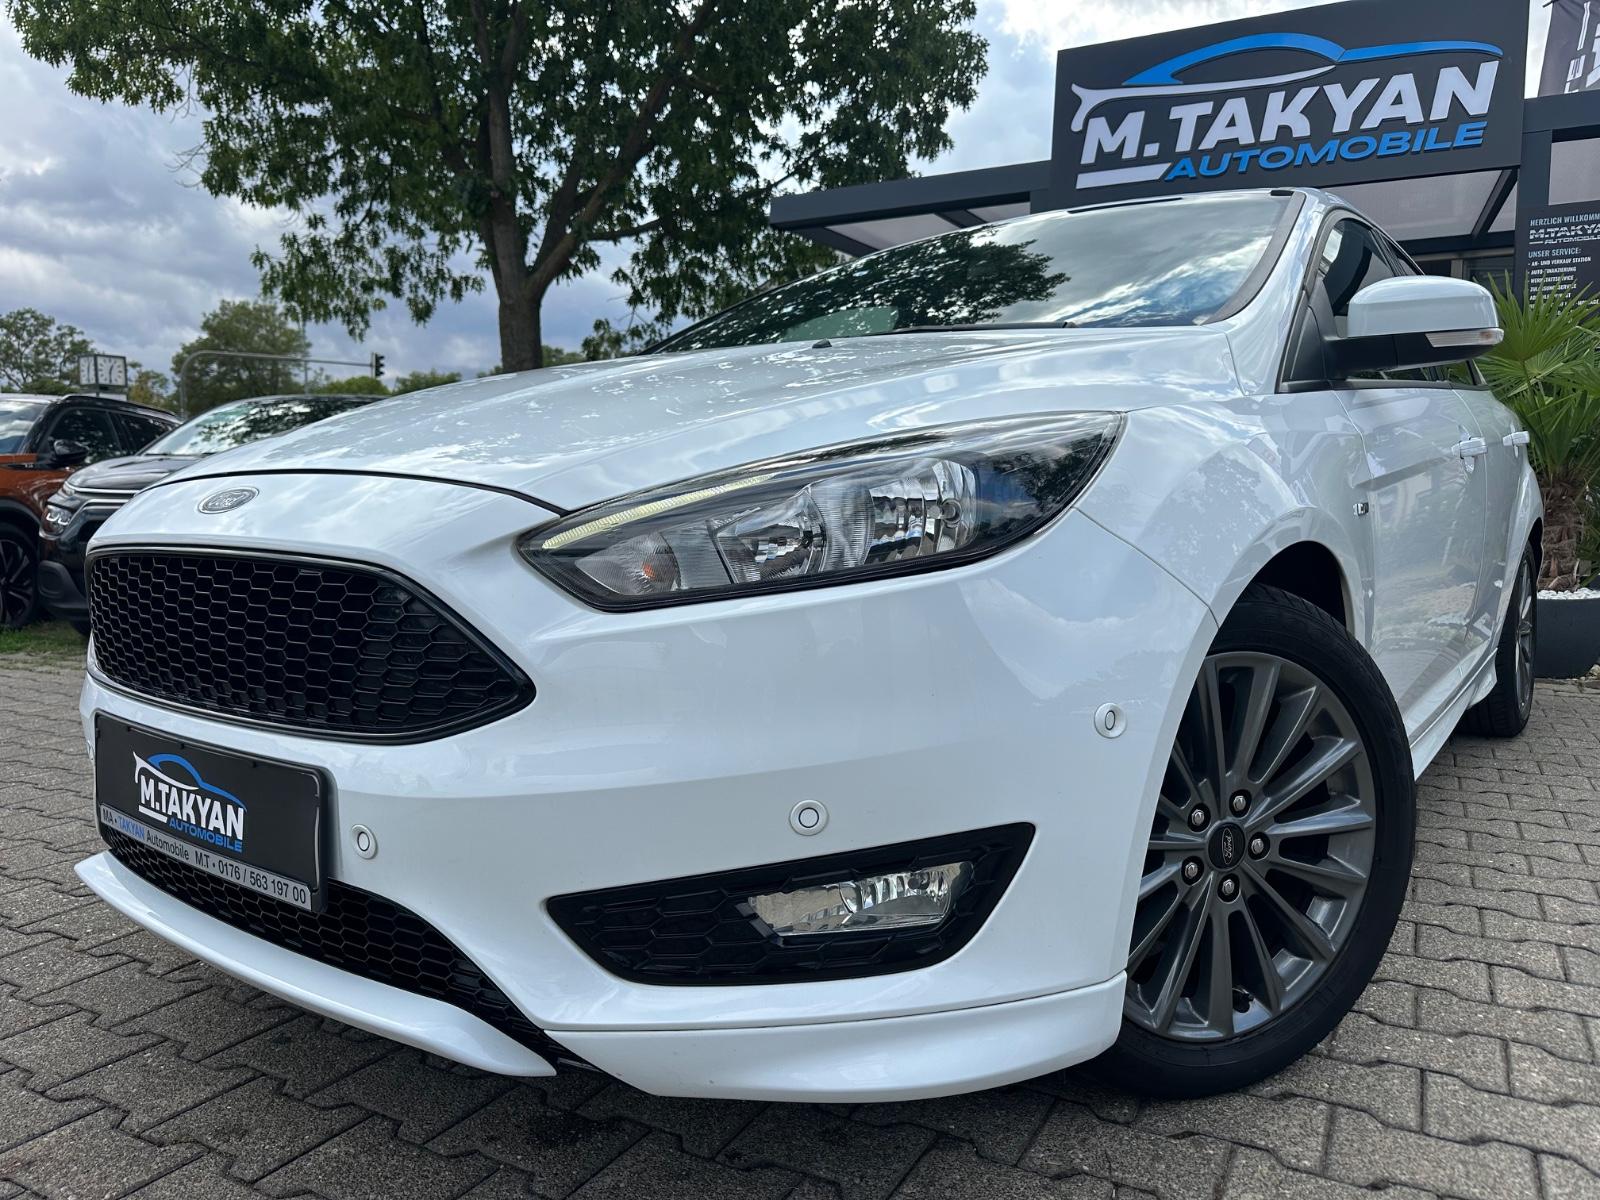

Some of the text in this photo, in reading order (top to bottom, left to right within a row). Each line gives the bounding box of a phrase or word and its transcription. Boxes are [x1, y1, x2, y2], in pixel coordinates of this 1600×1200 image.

[1164, 121, 1489, 182] AUTOMOBILE
[1530, 217, 1562, 226] HERZLICH
[1528, 250, 1550, 258] UNSER
[169, 817, 243, 853] AUTOMOBILE
[117, 816, 145, 841] TAKYAN
[146, 829, 190, 860] Automobile
[218, 859, 241, 880] 0176
[249, 870, 268, 891] 563
[271, 880, 289, 901] 197
[292, 886, 307, 905] 00
